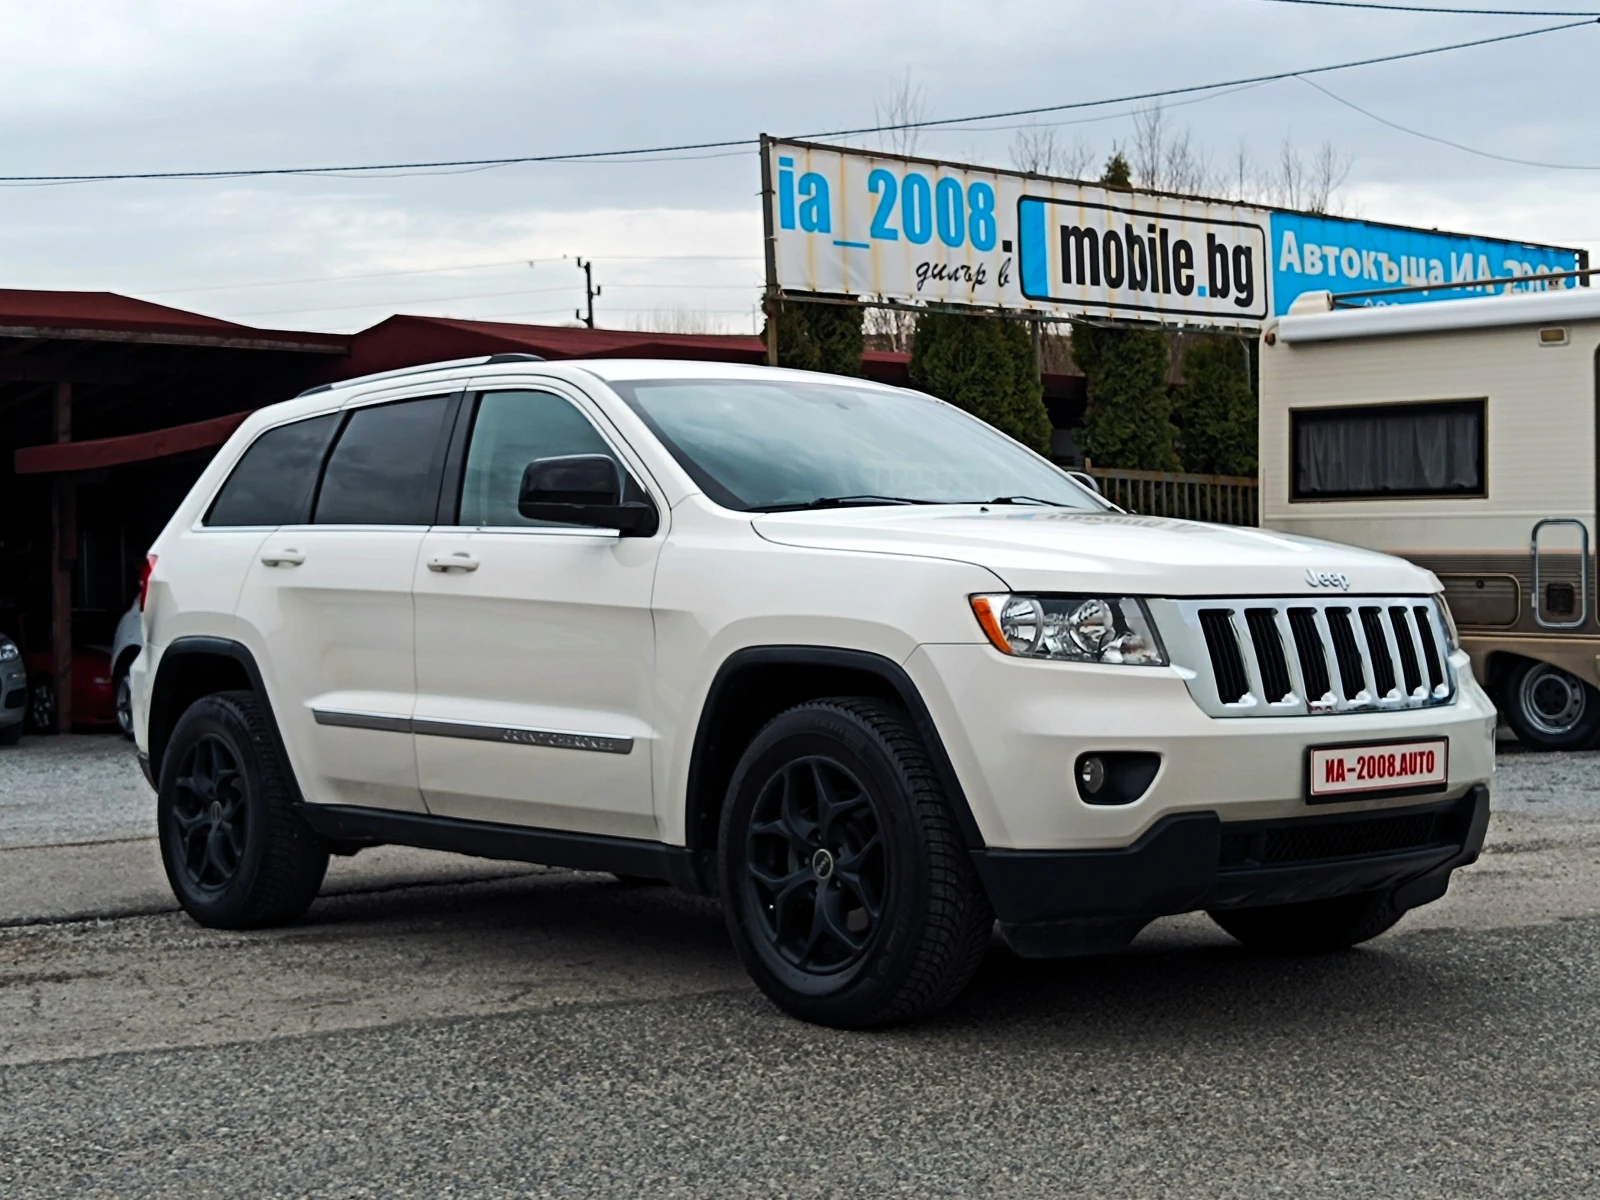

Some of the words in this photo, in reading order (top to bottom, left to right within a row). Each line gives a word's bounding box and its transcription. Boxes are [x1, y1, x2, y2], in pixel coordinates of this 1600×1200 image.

[1060, 223, 1254, 307] mobile.bg
[1279, 230, 1444, 296] Автокъща
[1305, 568, 1350, 590] Jeep
